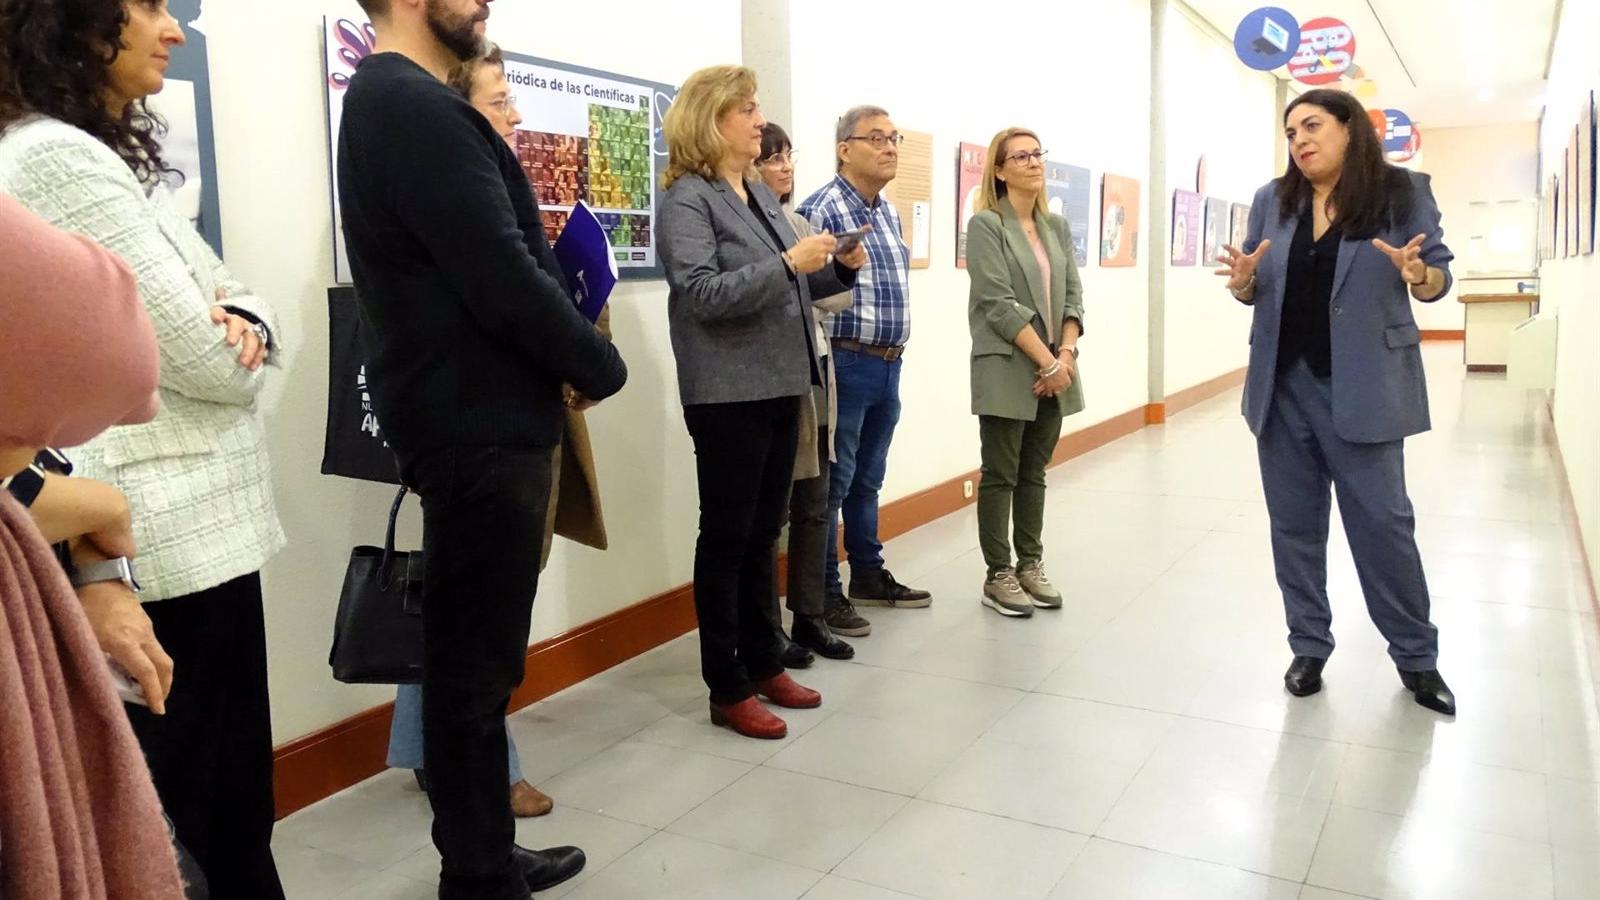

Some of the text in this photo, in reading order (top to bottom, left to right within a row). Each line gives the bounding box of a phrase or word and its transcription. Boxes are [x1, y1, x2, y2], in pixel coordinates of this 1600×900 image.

[506, 70, 635, 104] riódica de las Científicas
